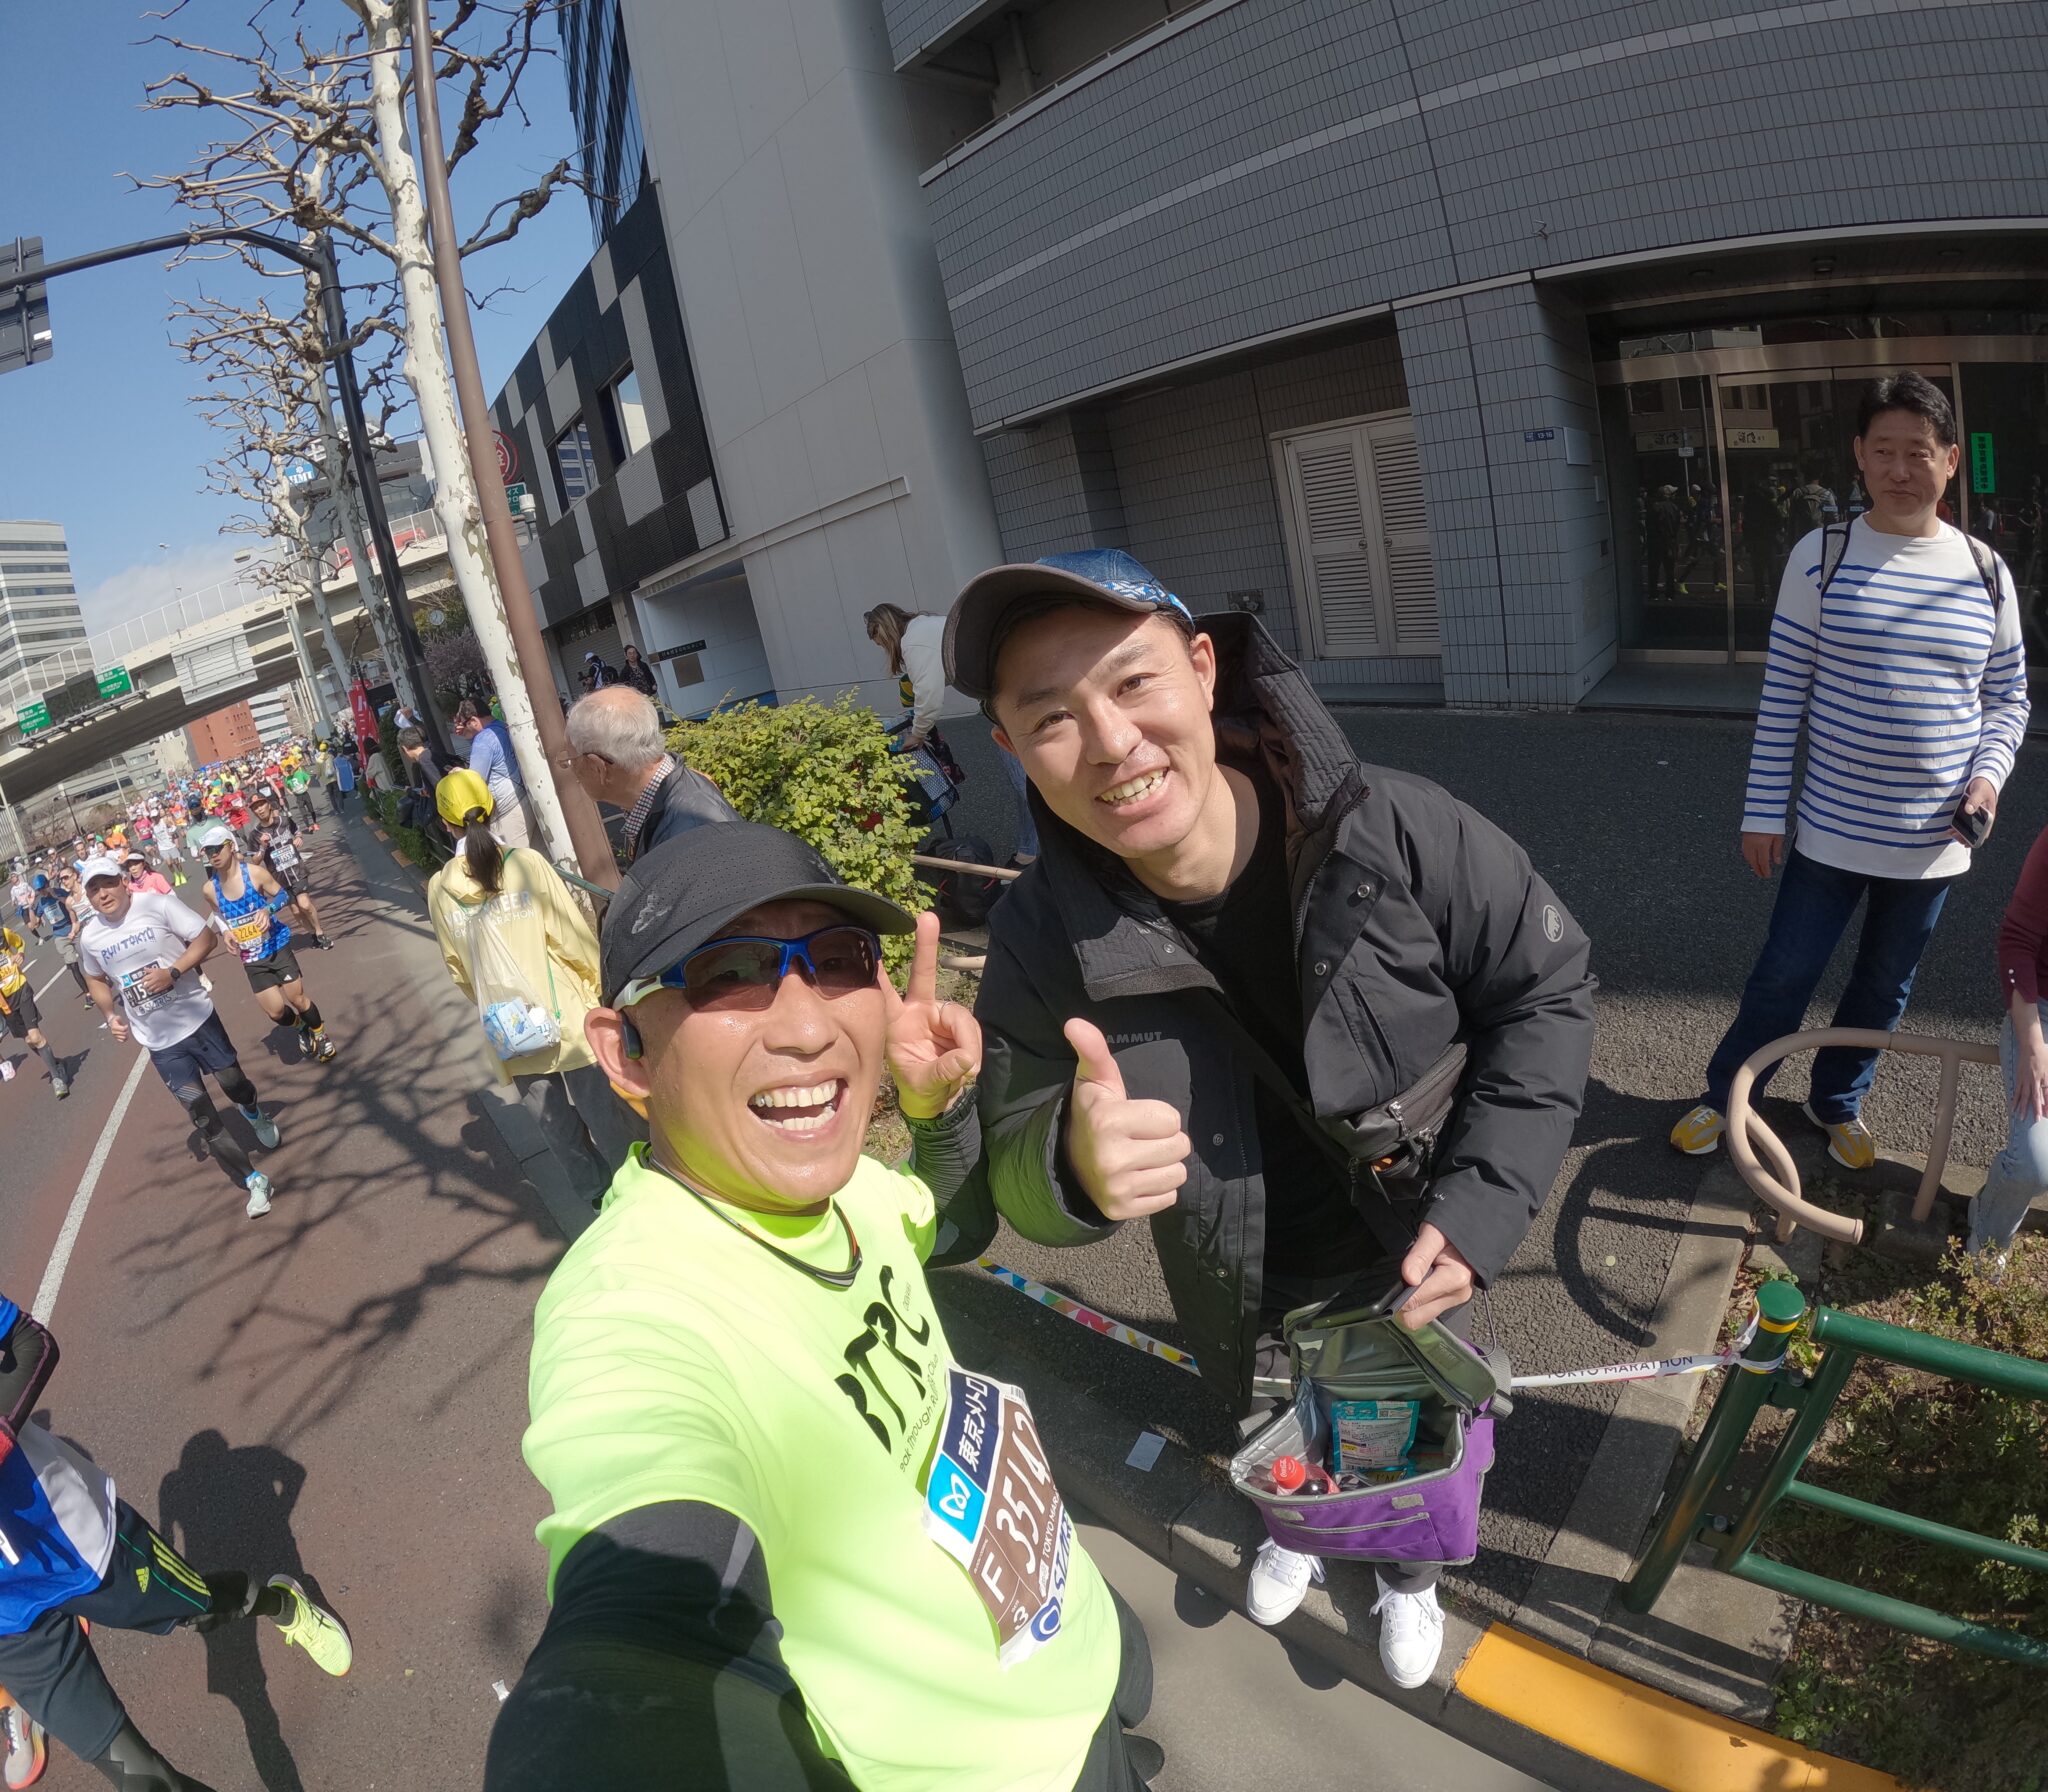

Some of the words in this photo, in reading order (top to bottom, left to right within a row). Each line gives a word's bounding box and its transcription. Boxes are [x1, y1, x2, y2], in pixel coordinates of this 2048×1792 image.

[1106, 1031, 1162, 1044] AMMUT
[1604, 1356, 1694, 1375] MARATHON
[957, 1374, 989, 1473] 東京メトロ
[1042, 1521, 1055, 1559] TOKYO
[980, 1551, 1005, 1605] F
[1013, 1609, 1029, 1632] 3
